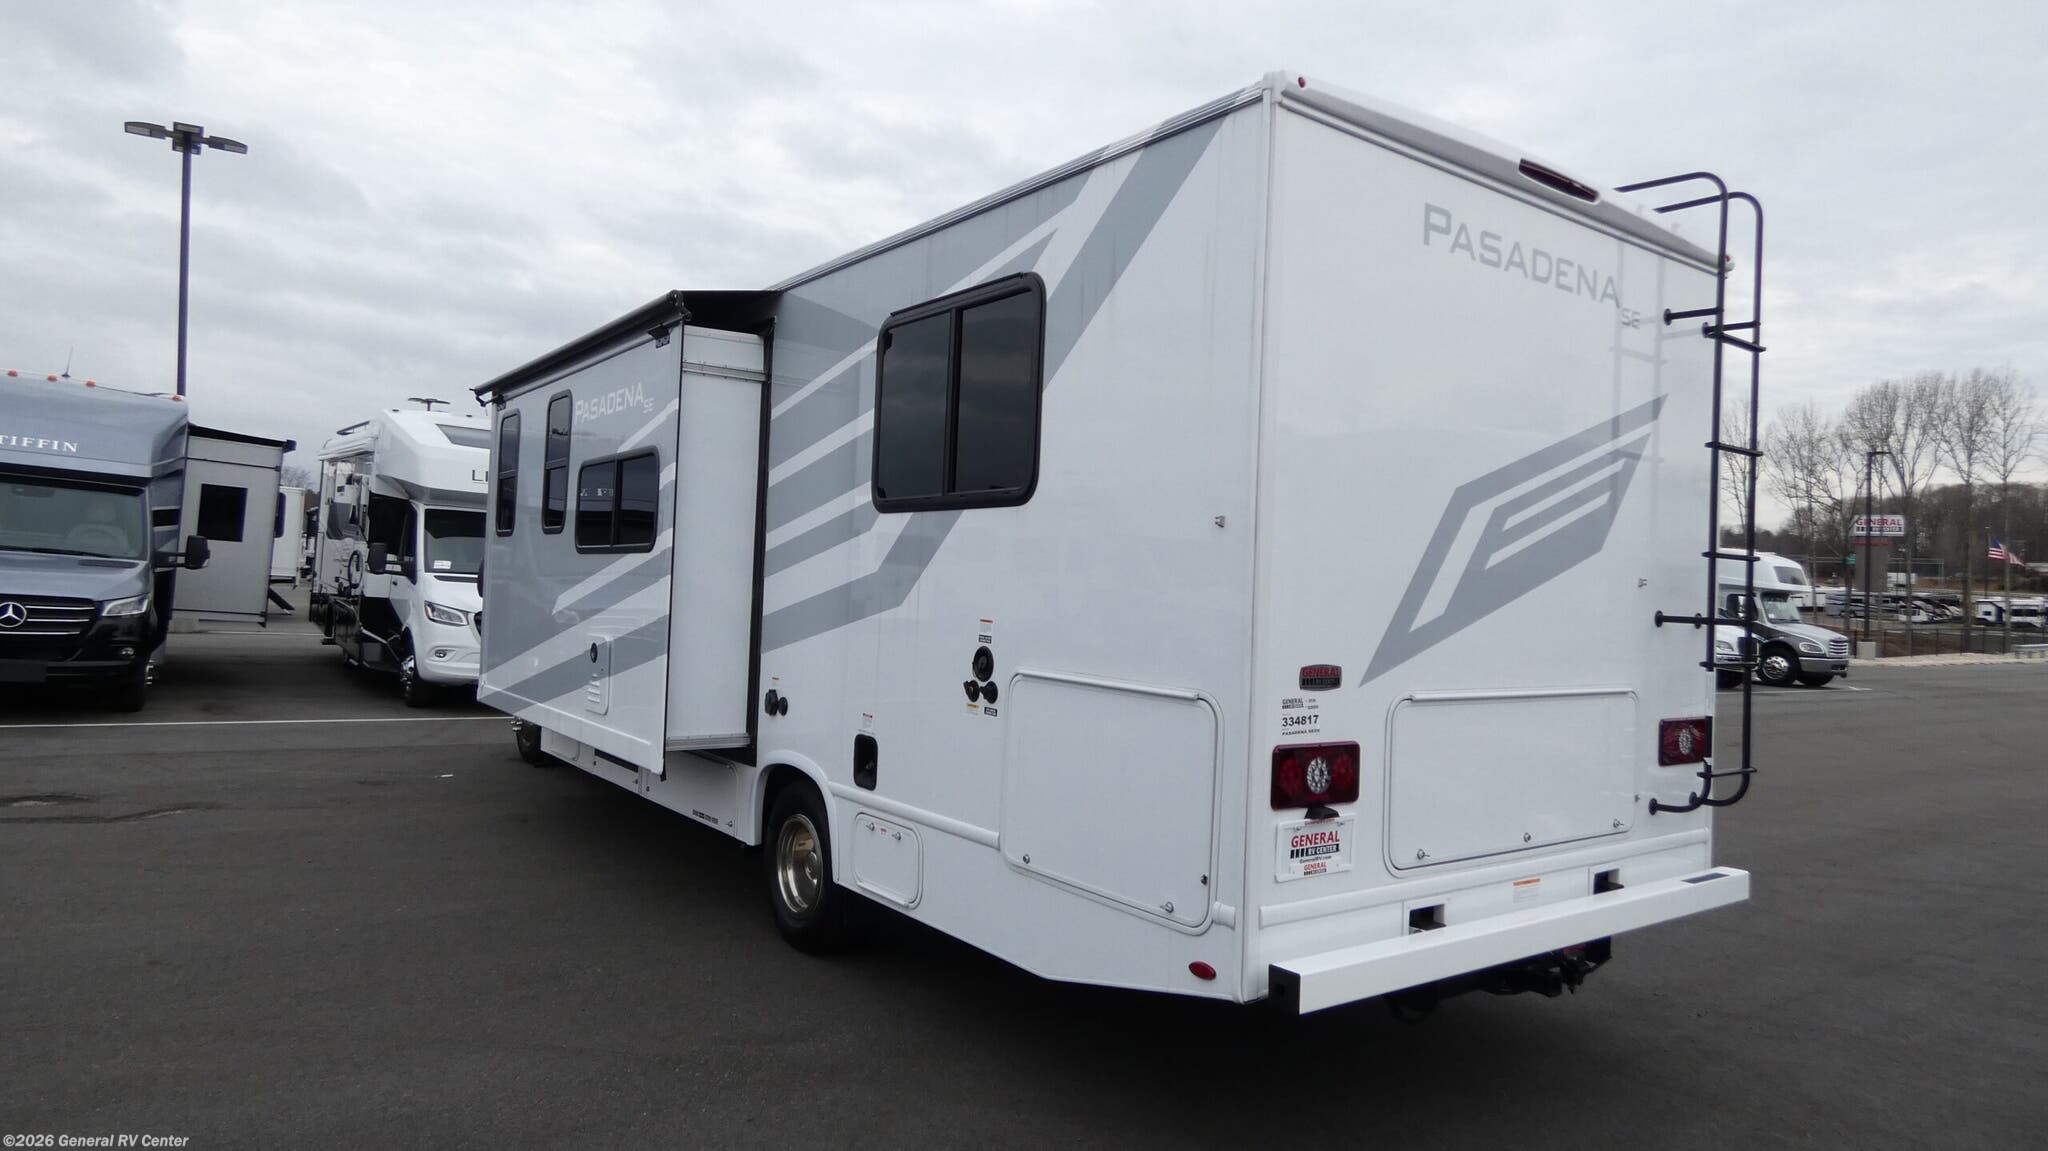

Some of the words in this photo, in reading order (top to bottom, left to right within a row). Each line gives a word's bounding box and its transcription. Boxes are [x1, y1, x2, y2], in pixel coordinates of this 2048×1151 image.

[1423, 202, 1621, 309] PASADENA
[1621, 306, 1640, 330] SE
[574, 382, 644, 426] PASADENA
[0, 434, 79, 453] TIFFIN
[1282, 715, 1319, 727] 334817
[1291, 831, 1340, 848] GENERAL
[1316, 844, 1337, 854] CENTER
[1304, 862, 1327, 871] GENERAL
